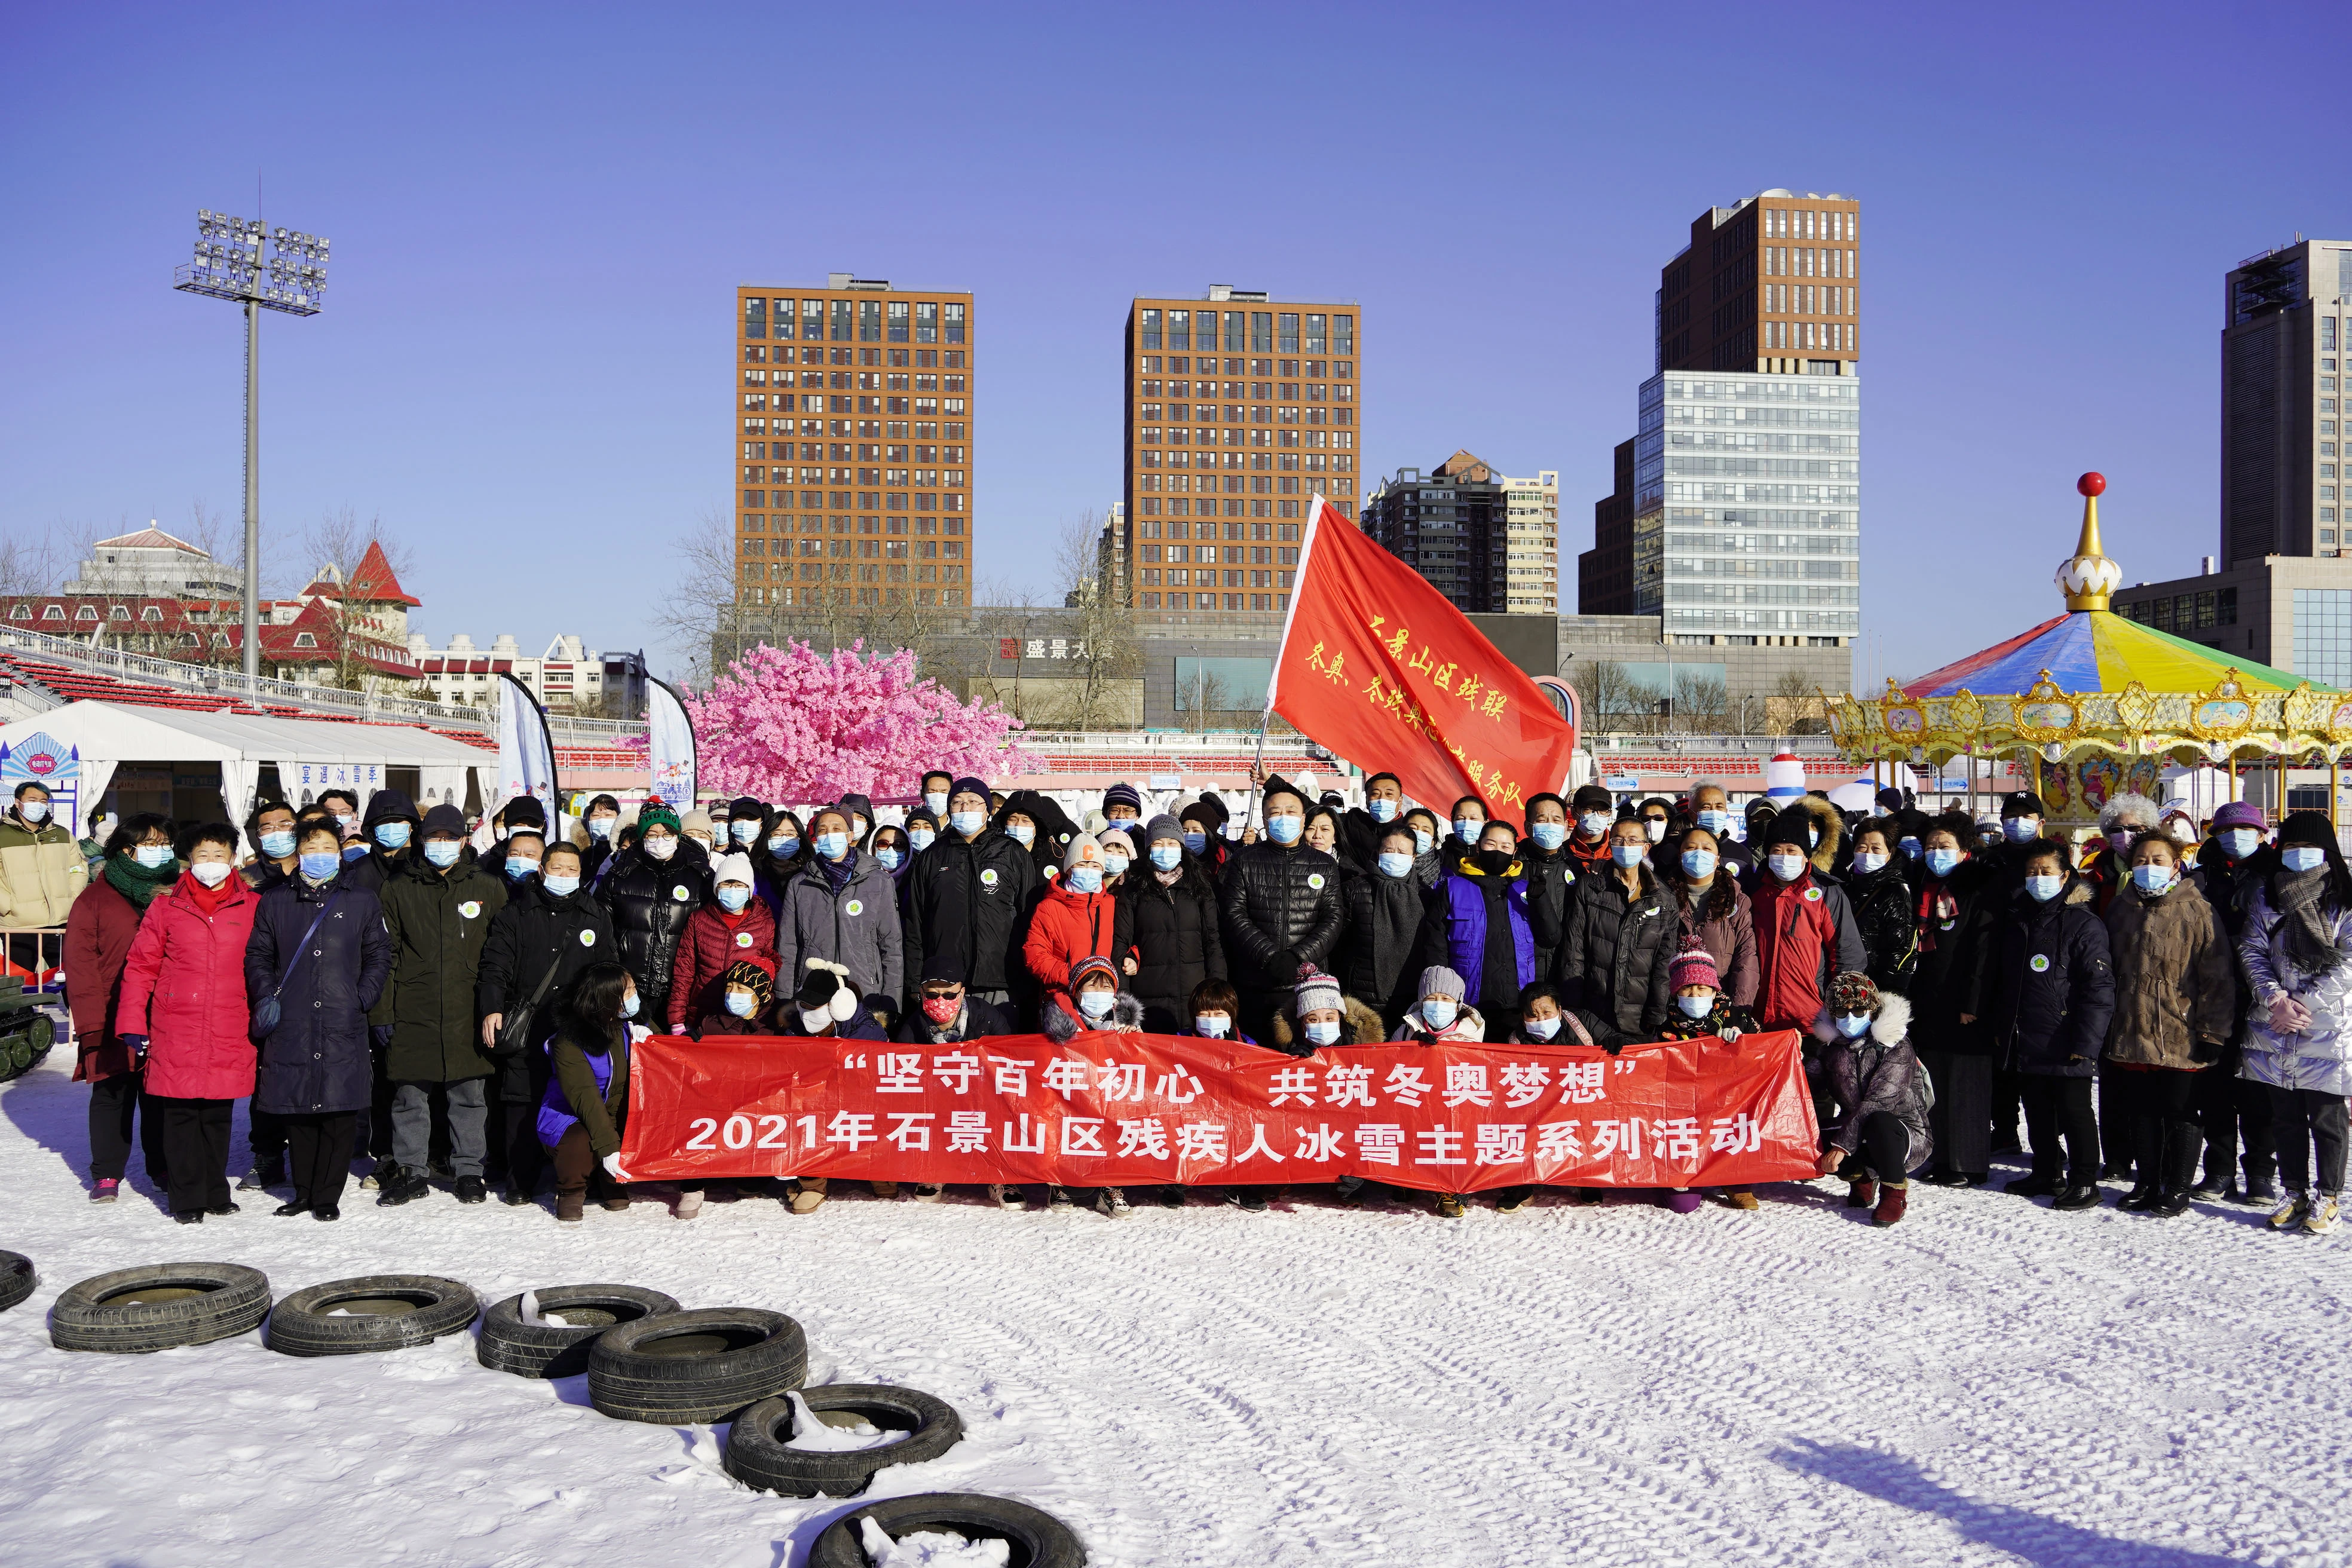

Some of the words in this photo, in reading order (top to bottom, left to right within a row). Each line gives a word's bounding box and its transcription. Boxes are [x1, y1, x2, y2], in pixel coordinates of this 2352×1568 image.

[302, 765, 377, 784] 宴遇冰雪季
[1083, 844, 1094, 860] C
[1575, 1024, 1589, 1040] THAT
[844, 1051, 1205, 1104] “坚守百年初心
[1268, 1060, 1636, 1109] 共筑冬奥梦想”
[685, 1110, 1761, 1166] 2021年石景山区残疾人冰雪主题系列活动
